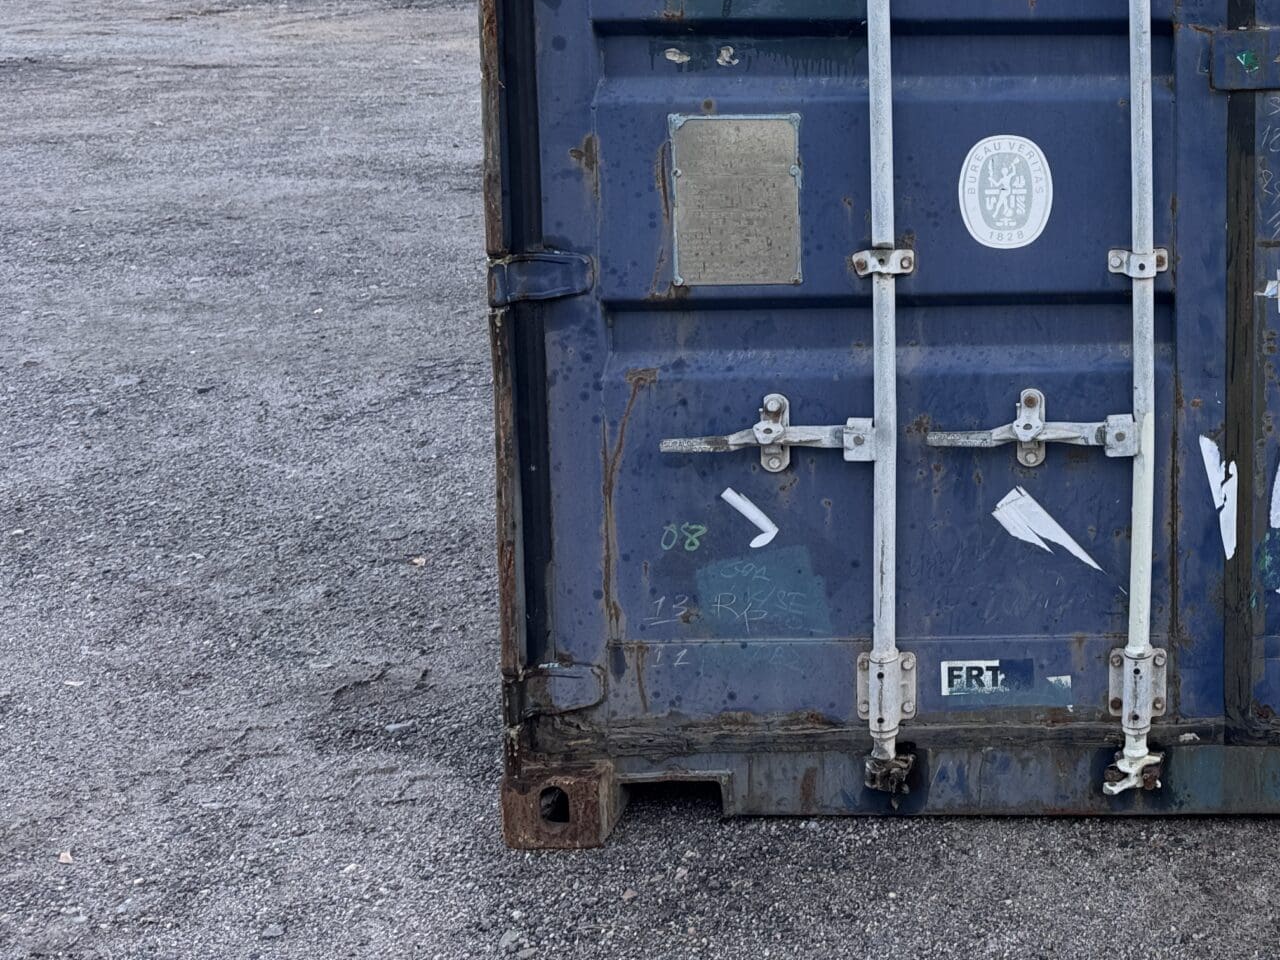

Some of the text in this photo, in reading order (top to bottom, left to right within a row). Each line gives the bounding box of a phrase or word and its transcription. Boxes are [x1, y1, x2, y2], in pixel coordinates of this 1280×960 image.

[967, 141, 1044, 195] BUREAU VERITAS
[989, 230, 1024, 241] 1828
